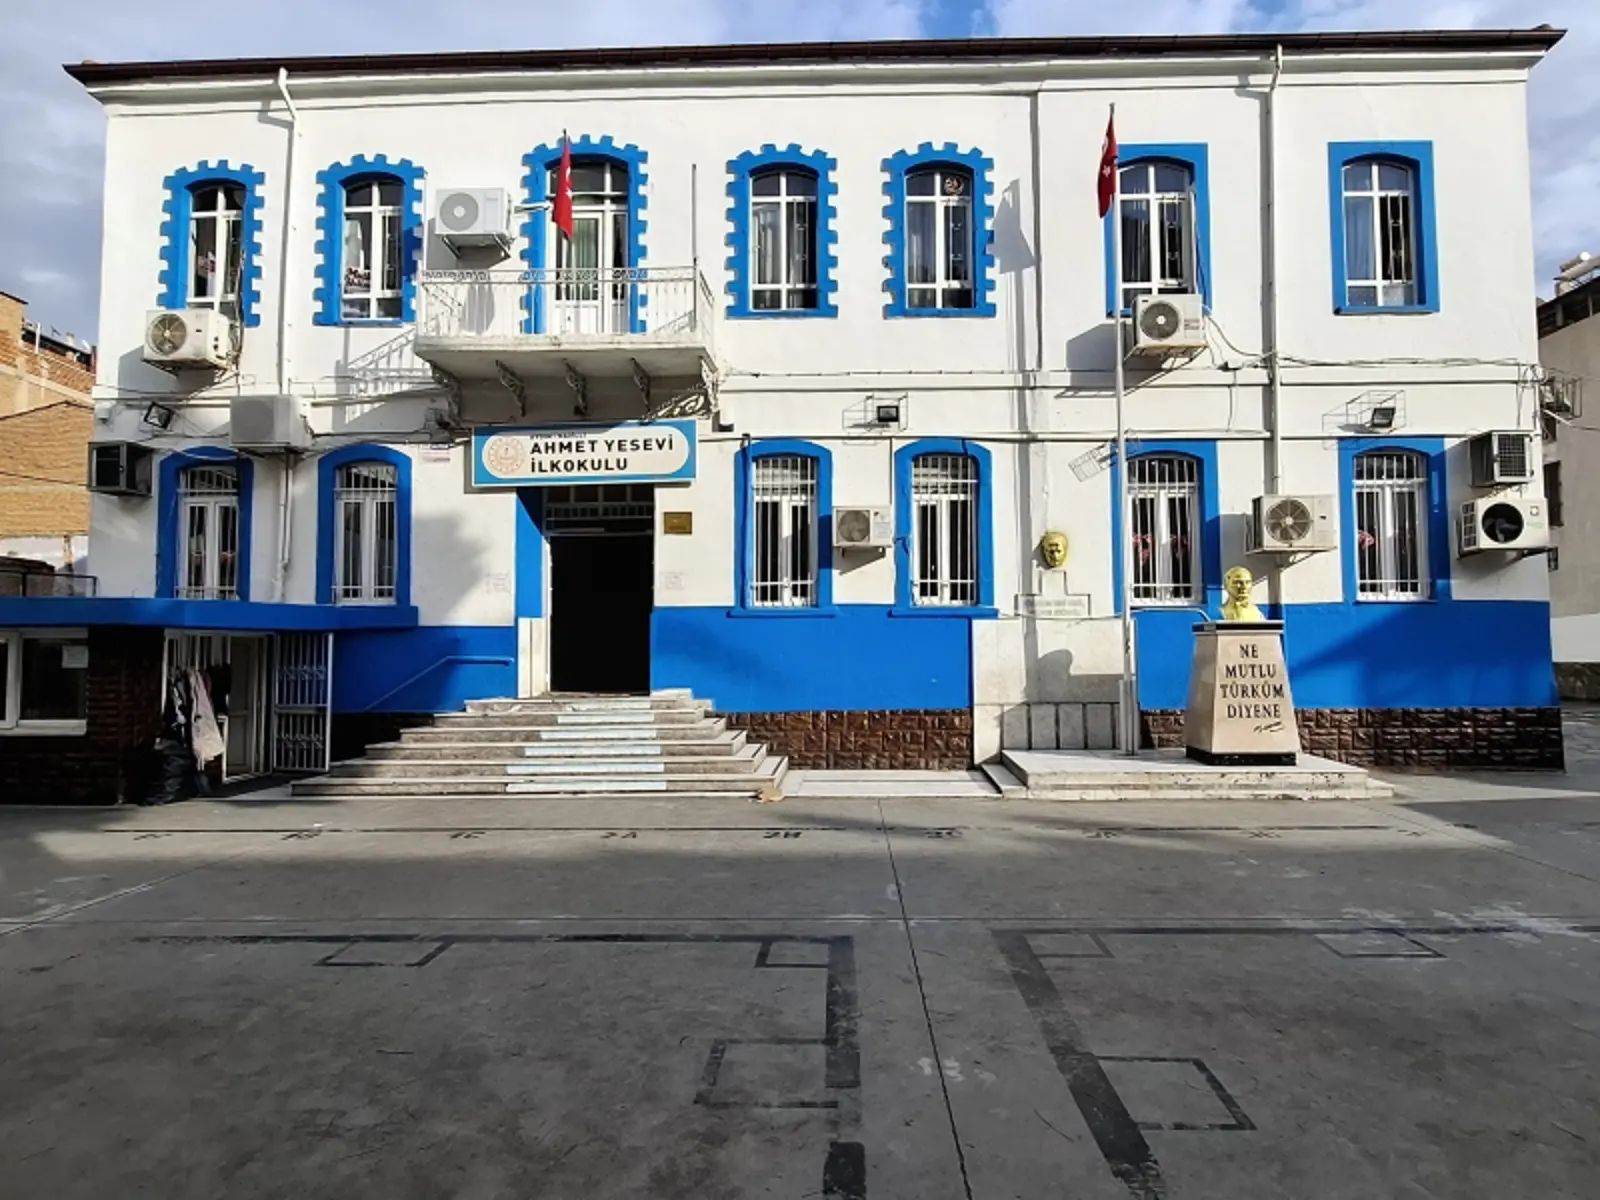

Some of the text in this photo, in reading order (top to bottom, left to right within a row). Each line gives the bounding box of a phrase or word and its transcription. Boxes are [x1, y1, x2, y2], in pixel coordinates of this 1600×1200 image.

[530, 440, 598, 454] AHMET
[604, 434, 673, 452] YESEVİ
[530, 458, 628, 473] İLKOKULU
[1240, 644, 1258, 658] NE
[1226, 664, 1276, 678] MUTLU
[1220, 681, 1284, 698] TÜRKÜM
